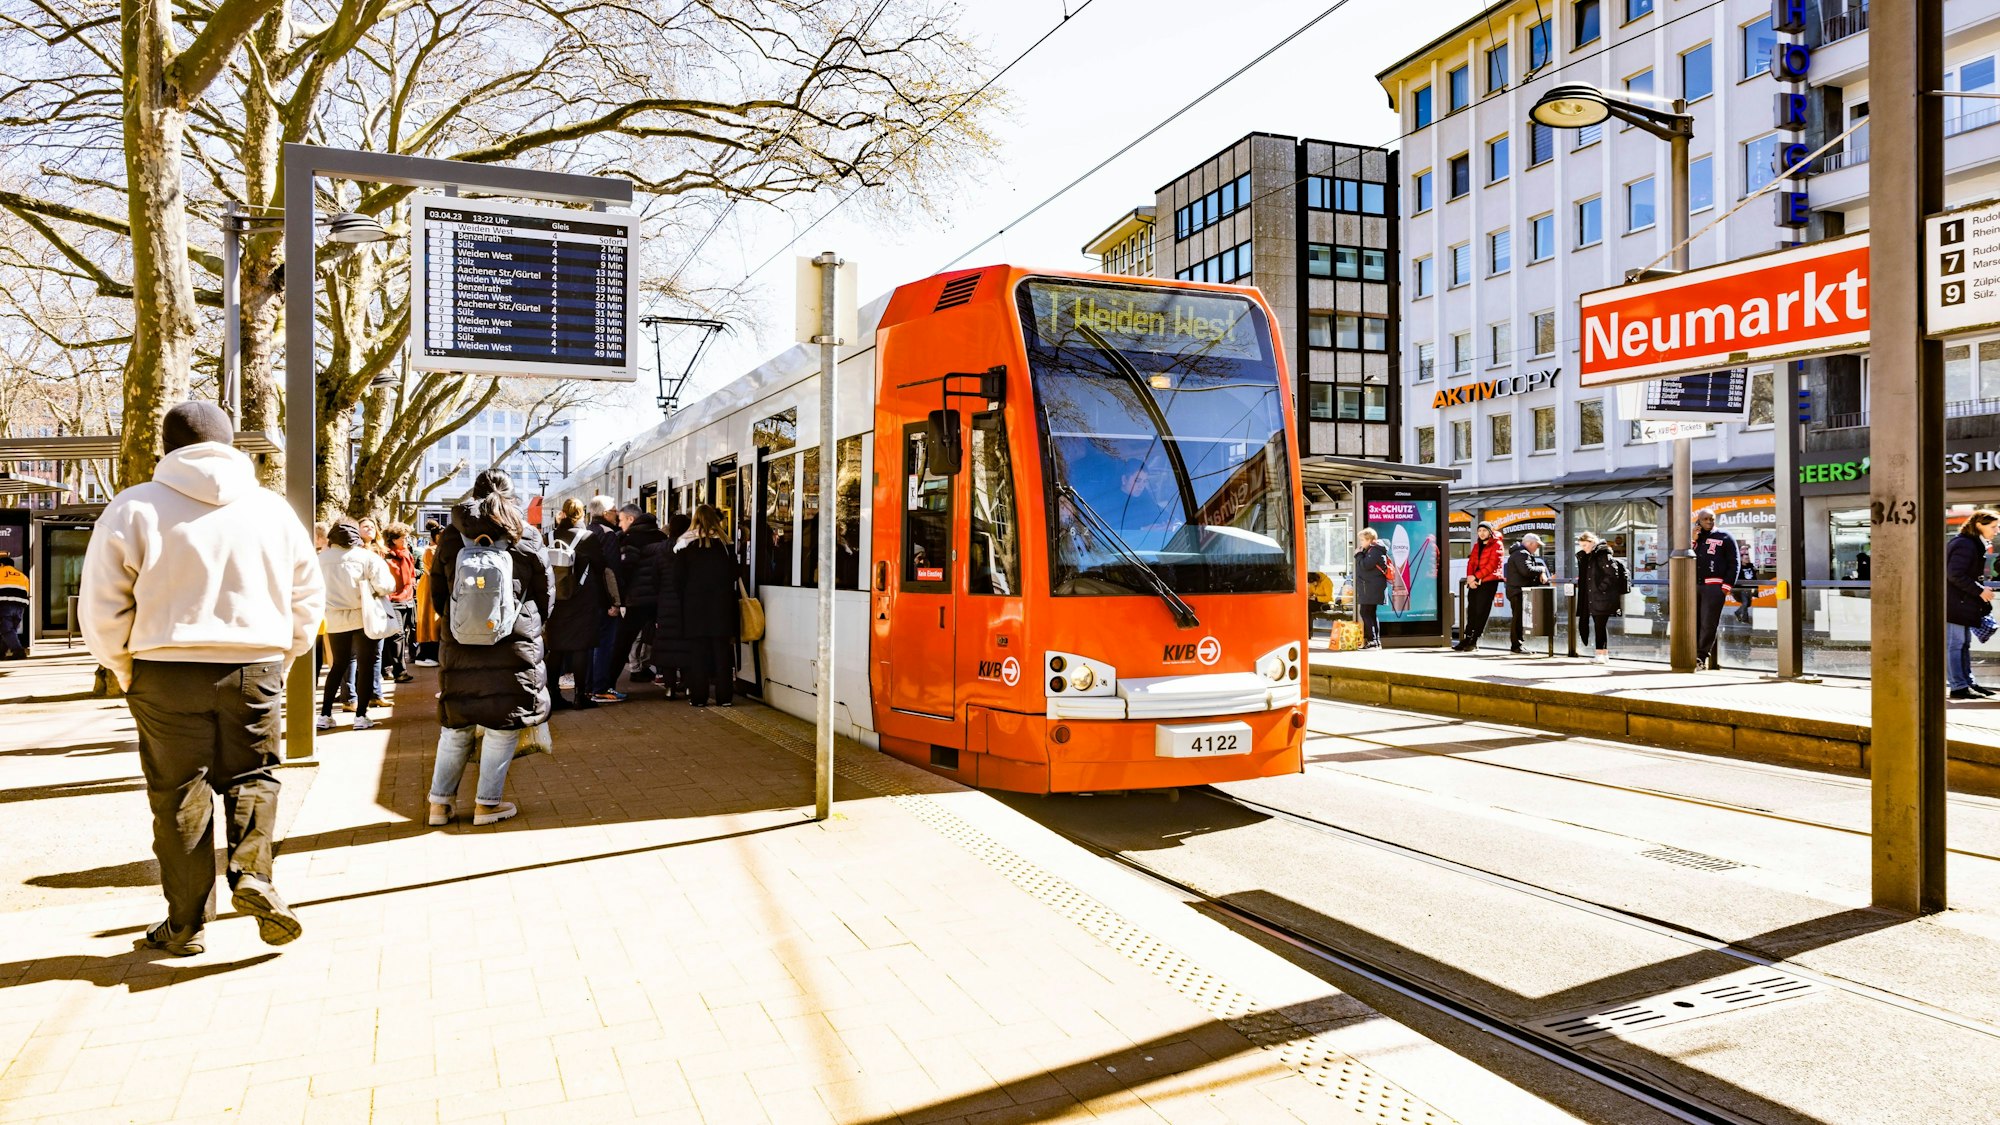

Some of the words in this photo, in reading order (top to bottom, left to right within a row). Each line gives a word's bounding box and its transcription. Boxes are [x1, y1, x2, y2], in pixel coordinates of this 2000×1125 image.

[430, 211, 462, 221] 03.04.23
[473, 216, 493, 224] 13:22
[552, 223, 569, 231] Gleis
[458, 224, 489, 233] Weiden
[491, 227, 513, 235] West
[599, 237, 623, 246] Sofort
[458, 232, 502, 243] Benzelrath
[1946, 223, 1956, 242] 1
[458, 241, 474, 249] Sülz
[458, 249, 489, 258] Weiden
[491, 252, 513, 260] West
[458, 258, 474, 266] Sülz
[1946, 253, 1960, 272] 7
[457, 266, 497, 276] Aachener
[499, 269, 541, 280] Str./Gürtel
[458, 274, 489, 284] Weiden
[491, 277, 512, 285] West
[458, 283, 501, 293] Benzelrath
[1946, 284, 1960, 303] 9
[458, 291, 489, 300] Weiden
[491, 294, 512, 302] West
[1973, 290, 1997, 300] Sülz.
[457, 300, 497, 309] Aachener
[498, 303, 541, 313] Str./Gürtel
[458, 317, 488, 325] Weiden
[491, 319, 512, 327] West
[1050, 292, 1058, 334] 1
[1074, 296, 1164, 336] Weiden
[1174, 304, 1236, 342] West
[1585, 268, 1868, 364] Neumarkt
[458, 325, 501, 334] Benzelrath
[458, 342, 488, 350] Weiden
[1432, 368, 1561, 409] AKTIVCOPY
[1680, 424, 1702, 432] Tickets
[1870, 500, 1917, 525] 343
[1491, 508, 1530, 531] igitaldruck
[1502, 522, 1536, 534] STUDENTEN
[1705, 538, 1724, 555] T
[926, 570, 943, 578] Einstieg
[1162, 644, 1197, 662] KVB
[978, 660, 1002, 678] KVB
[1191, 735, 1237, 752] 4122
